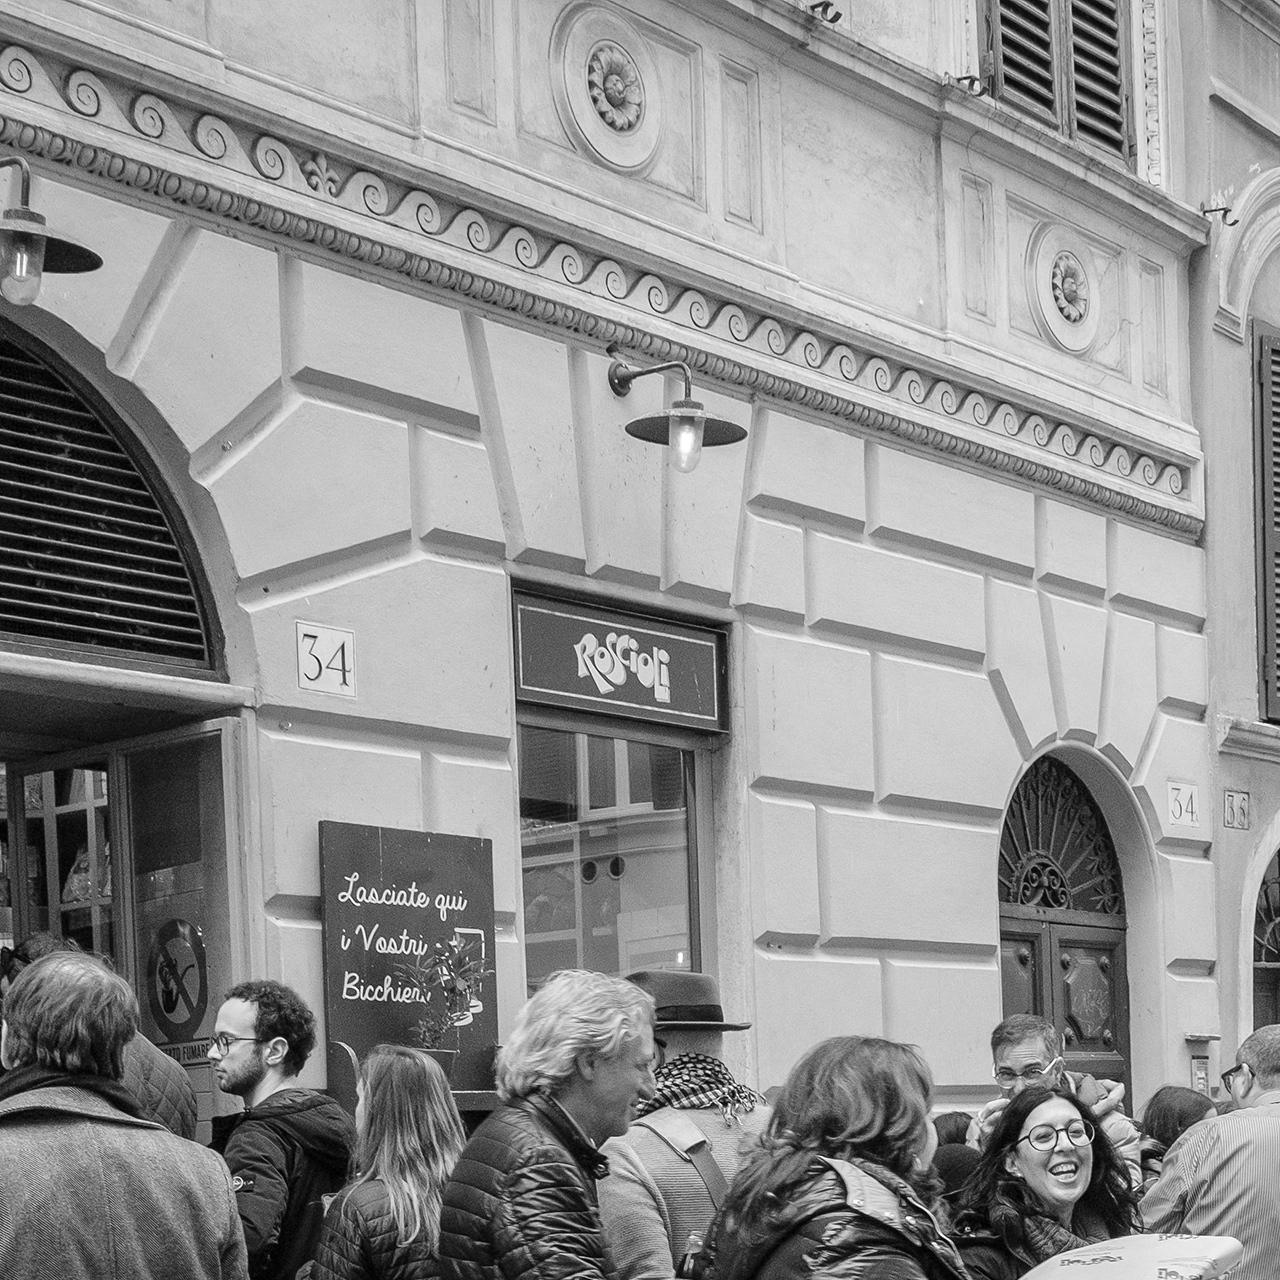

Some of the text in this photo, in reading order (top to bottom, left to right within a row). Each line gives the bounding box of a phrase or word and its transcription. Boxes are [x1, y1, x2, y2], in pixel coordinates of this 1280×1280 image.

[301, 633, 352, 688] 34
[1171, 787, 1197, 822] 34
[338, 872, 468, 921] Lasciate qui
[341, 924, 428, 957] i Vostri
